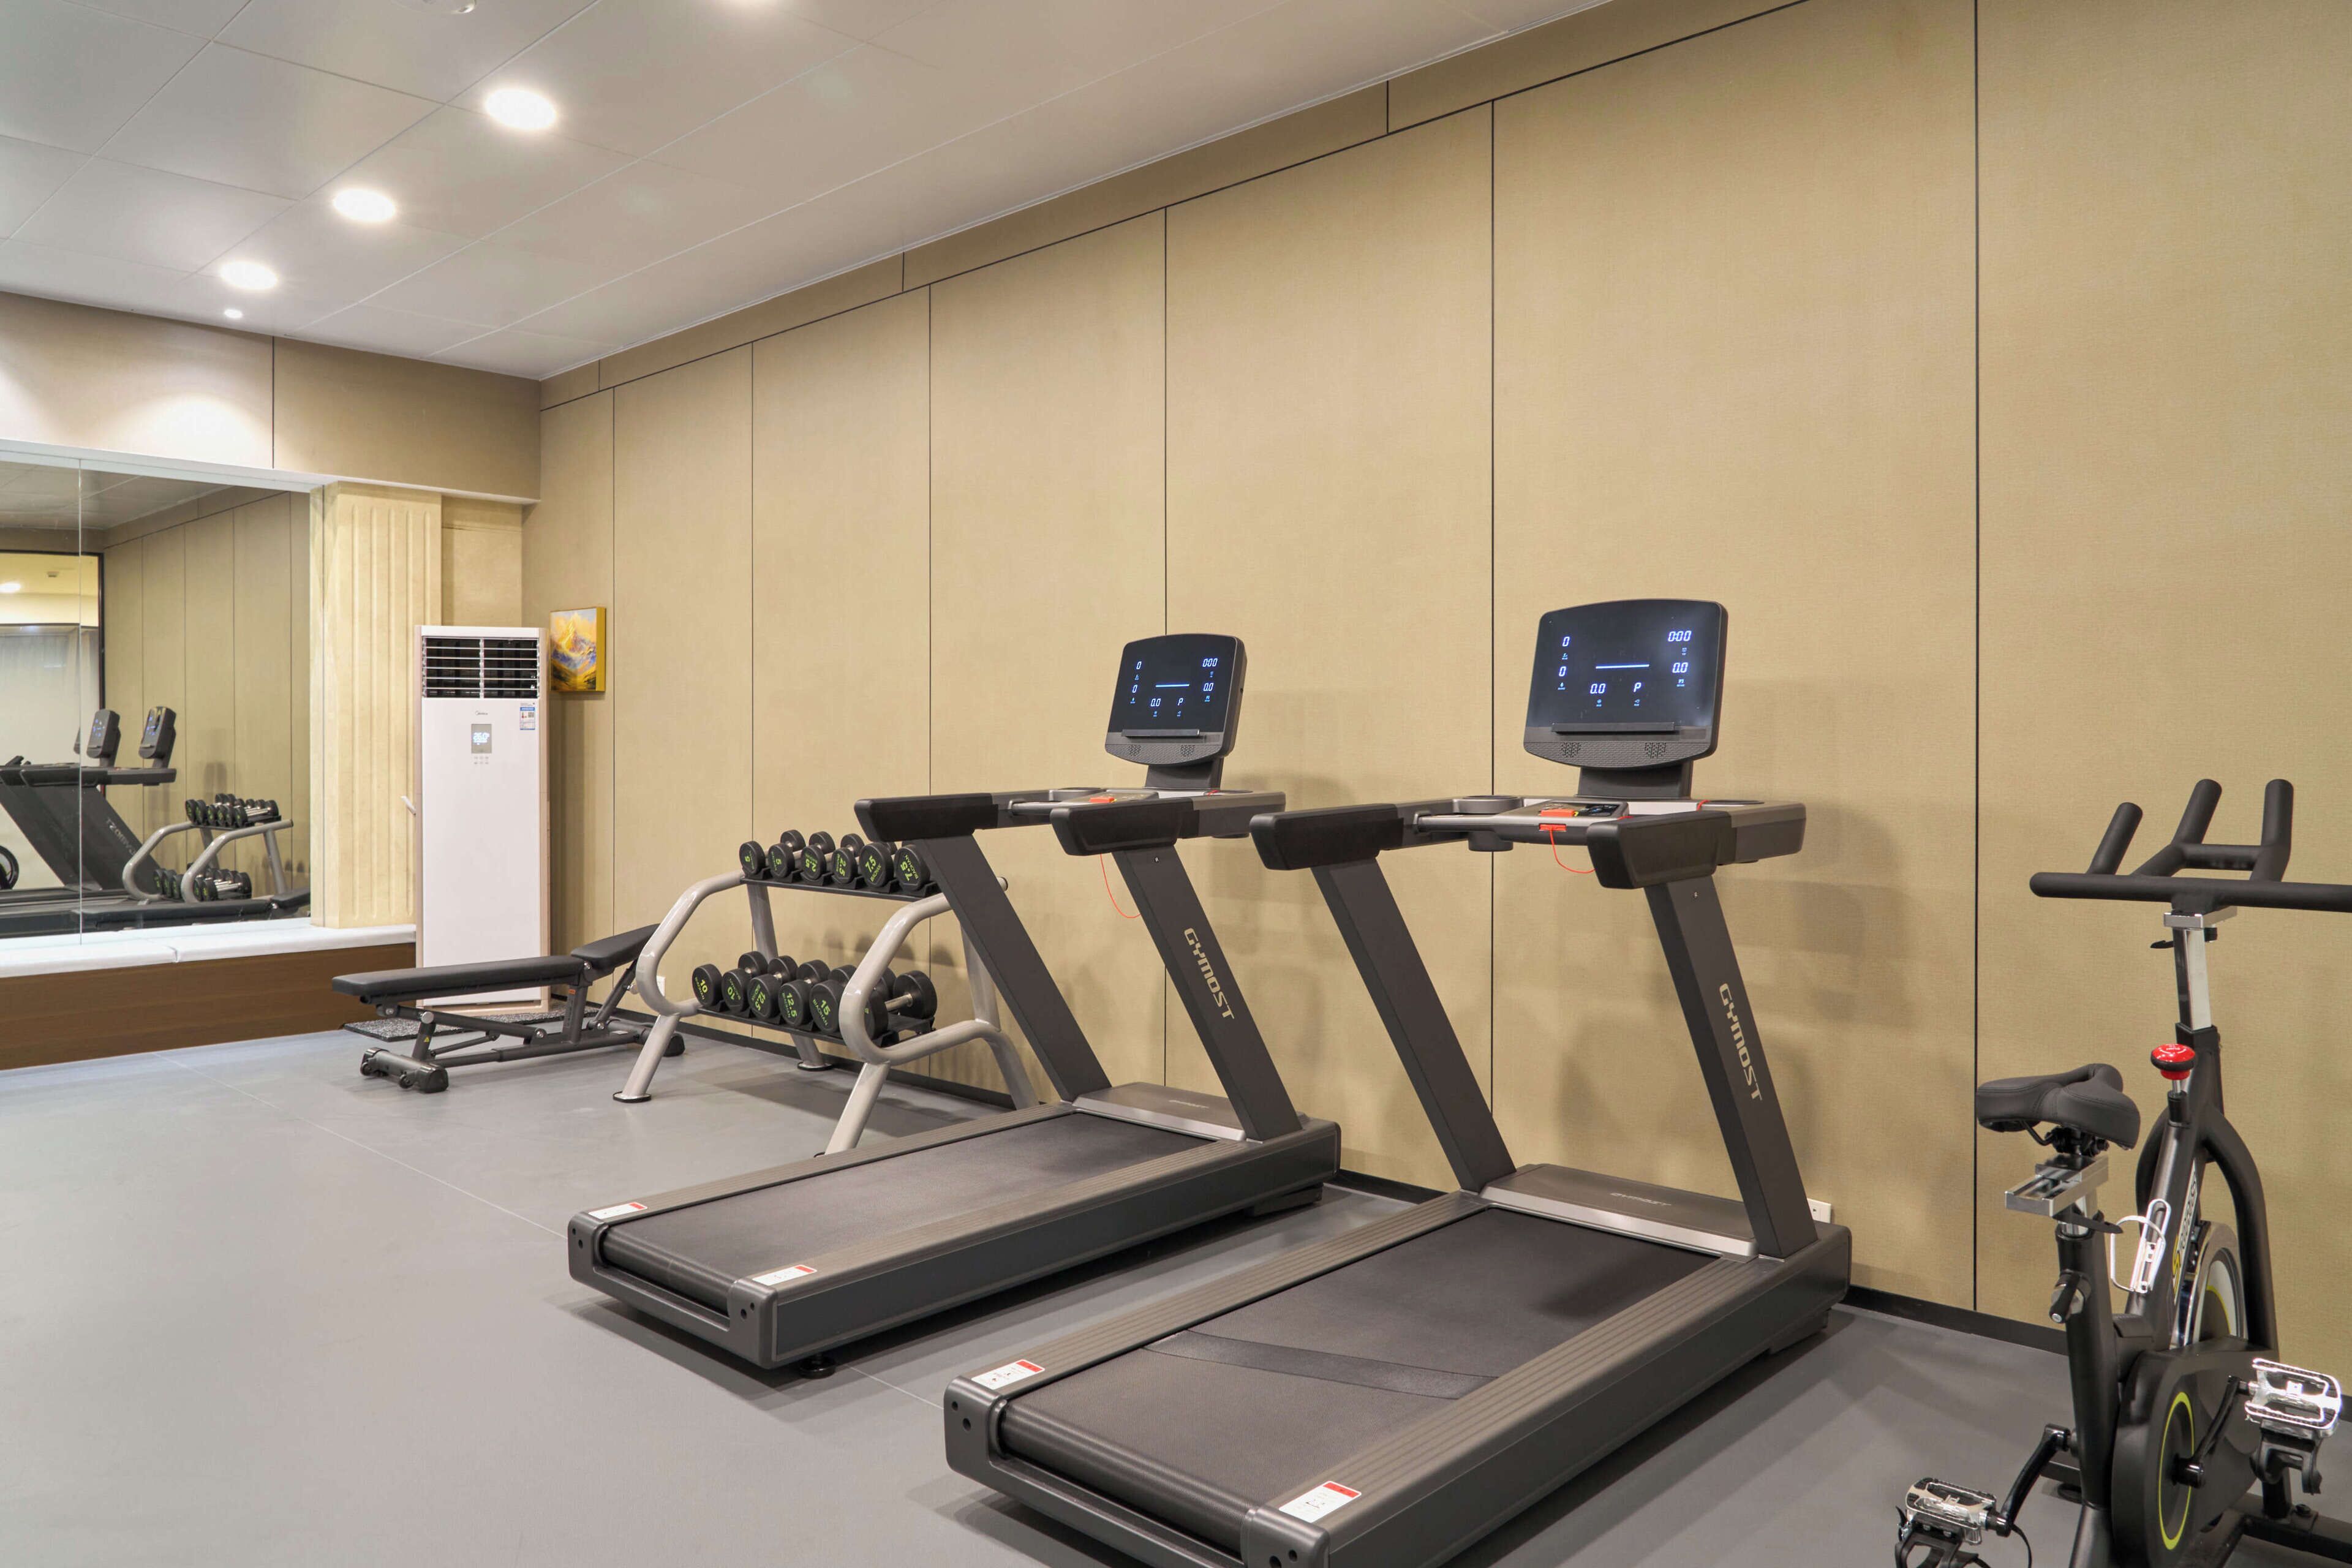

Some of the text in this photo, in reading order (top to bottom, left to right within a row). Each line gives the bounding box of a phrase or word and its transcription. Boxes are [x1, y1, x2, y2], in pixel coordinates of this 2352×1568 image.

[1562, 636, 1570, 647] 0
[1668, 630, 1692, 642] 0:00
[1136, 661, 1142, 669] 0
[1559, 666, 1567, 677] 0
[1672, 662, 1689, 673] 0.0
[1204, 682, 1214, 692] 0.0
[1590, 683, 1606, 694] 0.0
[1634, 682, 1642, 692] P
[1150, 698, 1161, 707] 0.0
[805, 858, 816, 872] 2.5
[865, 855, 876, 873] 7.5
[900, 861, 913, 881] 7.5
[1184, 927, 1235, 1019] GYMOST
[700, 979, 708, 993] 10
[728, 986, 735, 1000] 10
[755, 991, 766, 1011] 12.5
[786, 992, 797, 1017] 12.5
[820, 1000, 831, 1016] 15
[1719, 983, 1762, 1101] GYMOST
